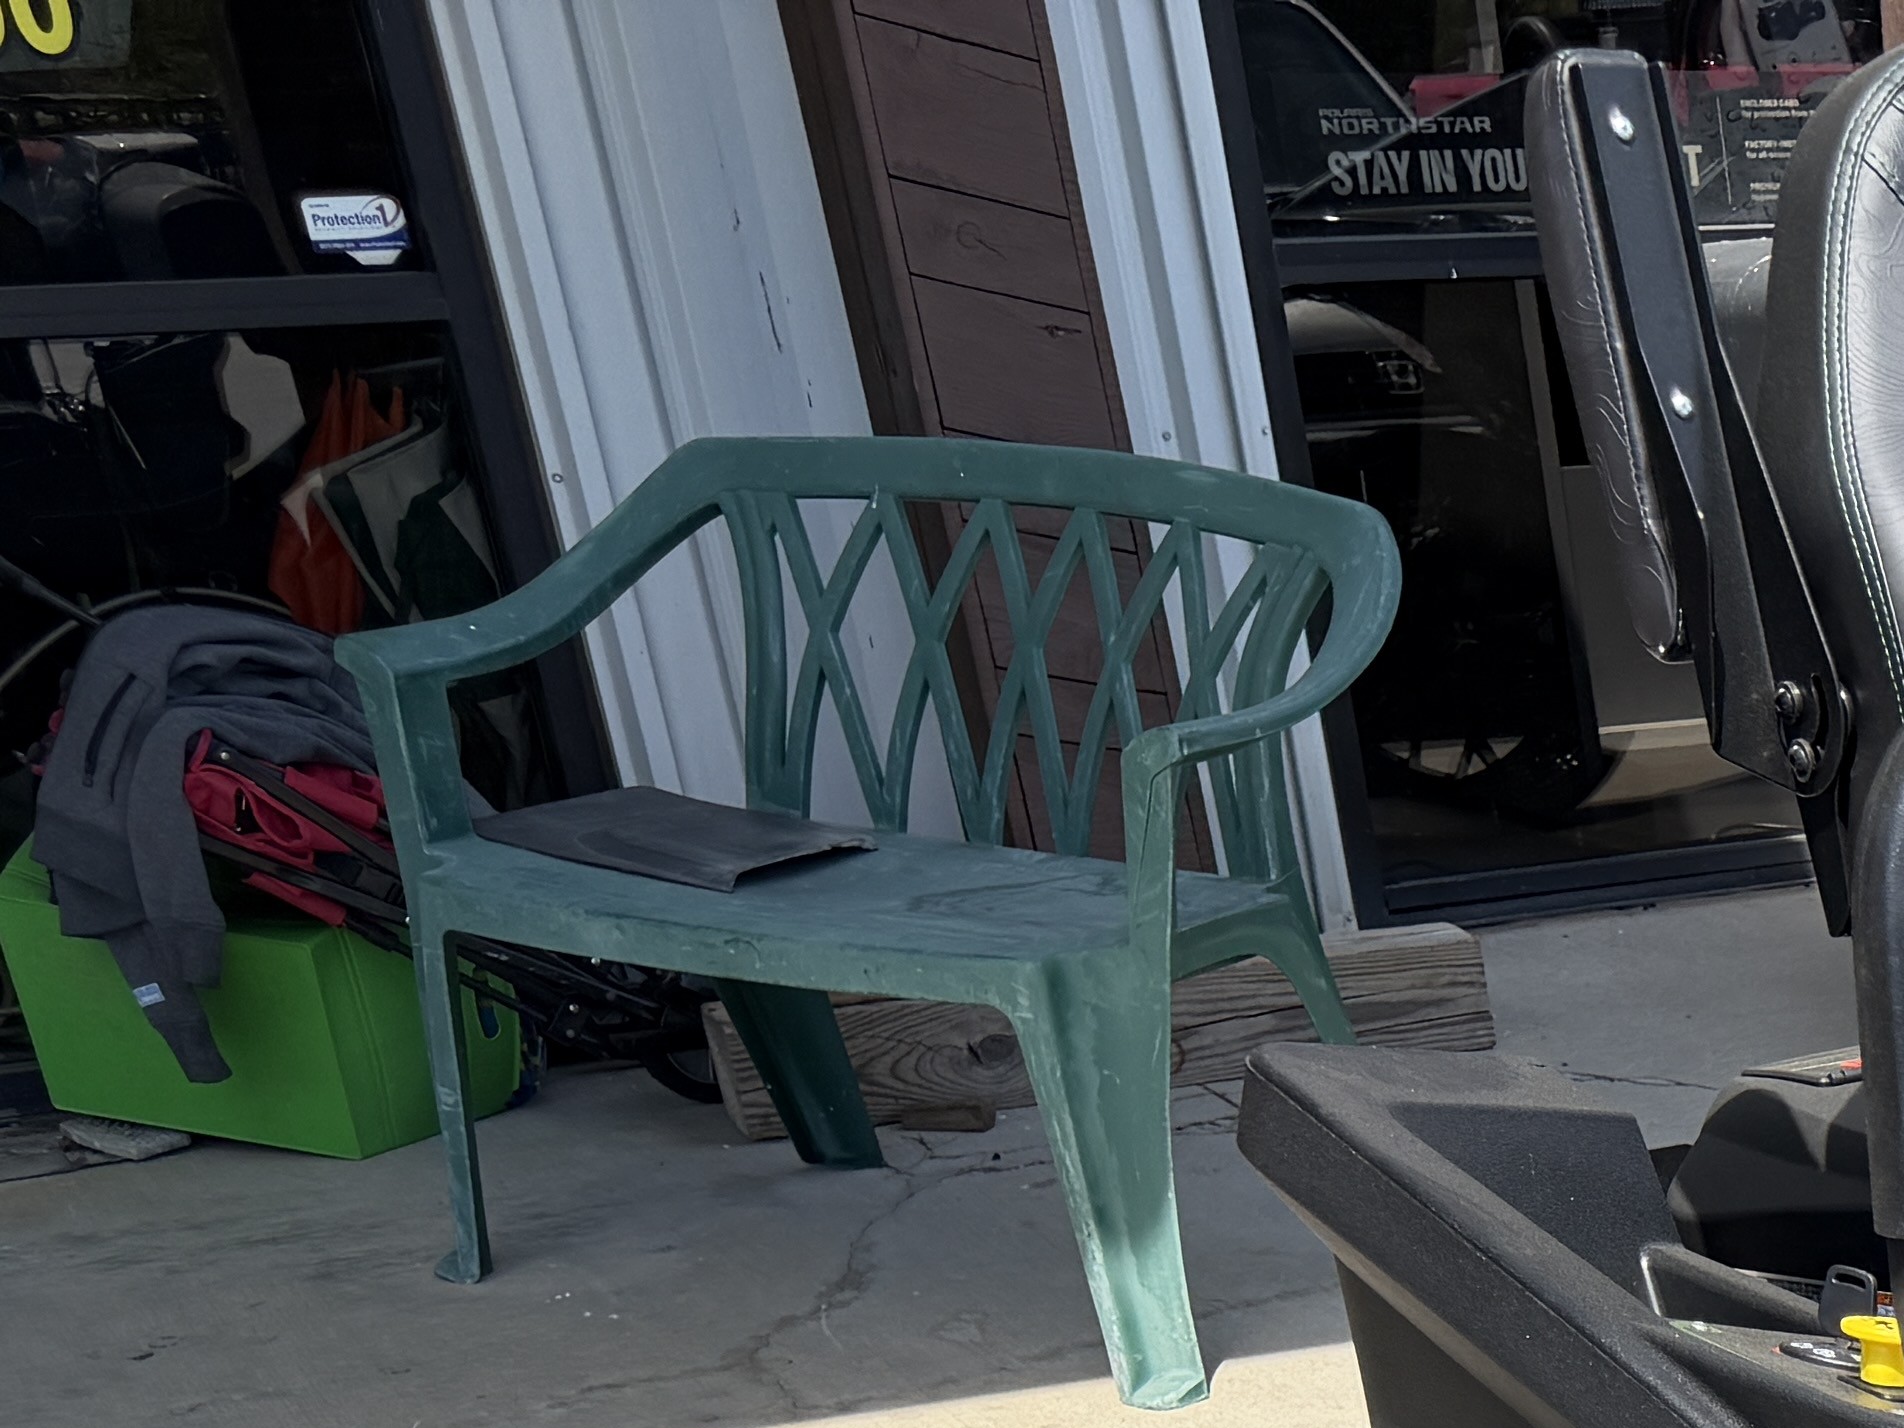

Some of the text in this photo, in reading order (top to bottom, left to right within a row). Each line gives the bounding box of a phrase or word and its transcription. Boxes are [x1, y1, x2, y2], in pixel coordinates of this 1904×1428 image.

[1321, 116, 1492, 136] NORTHSTAR
[1327, 150, 1410, 196] STAY
[1419, 149, 1458, 193] IN
[311, 213, 382, 228] Protection
